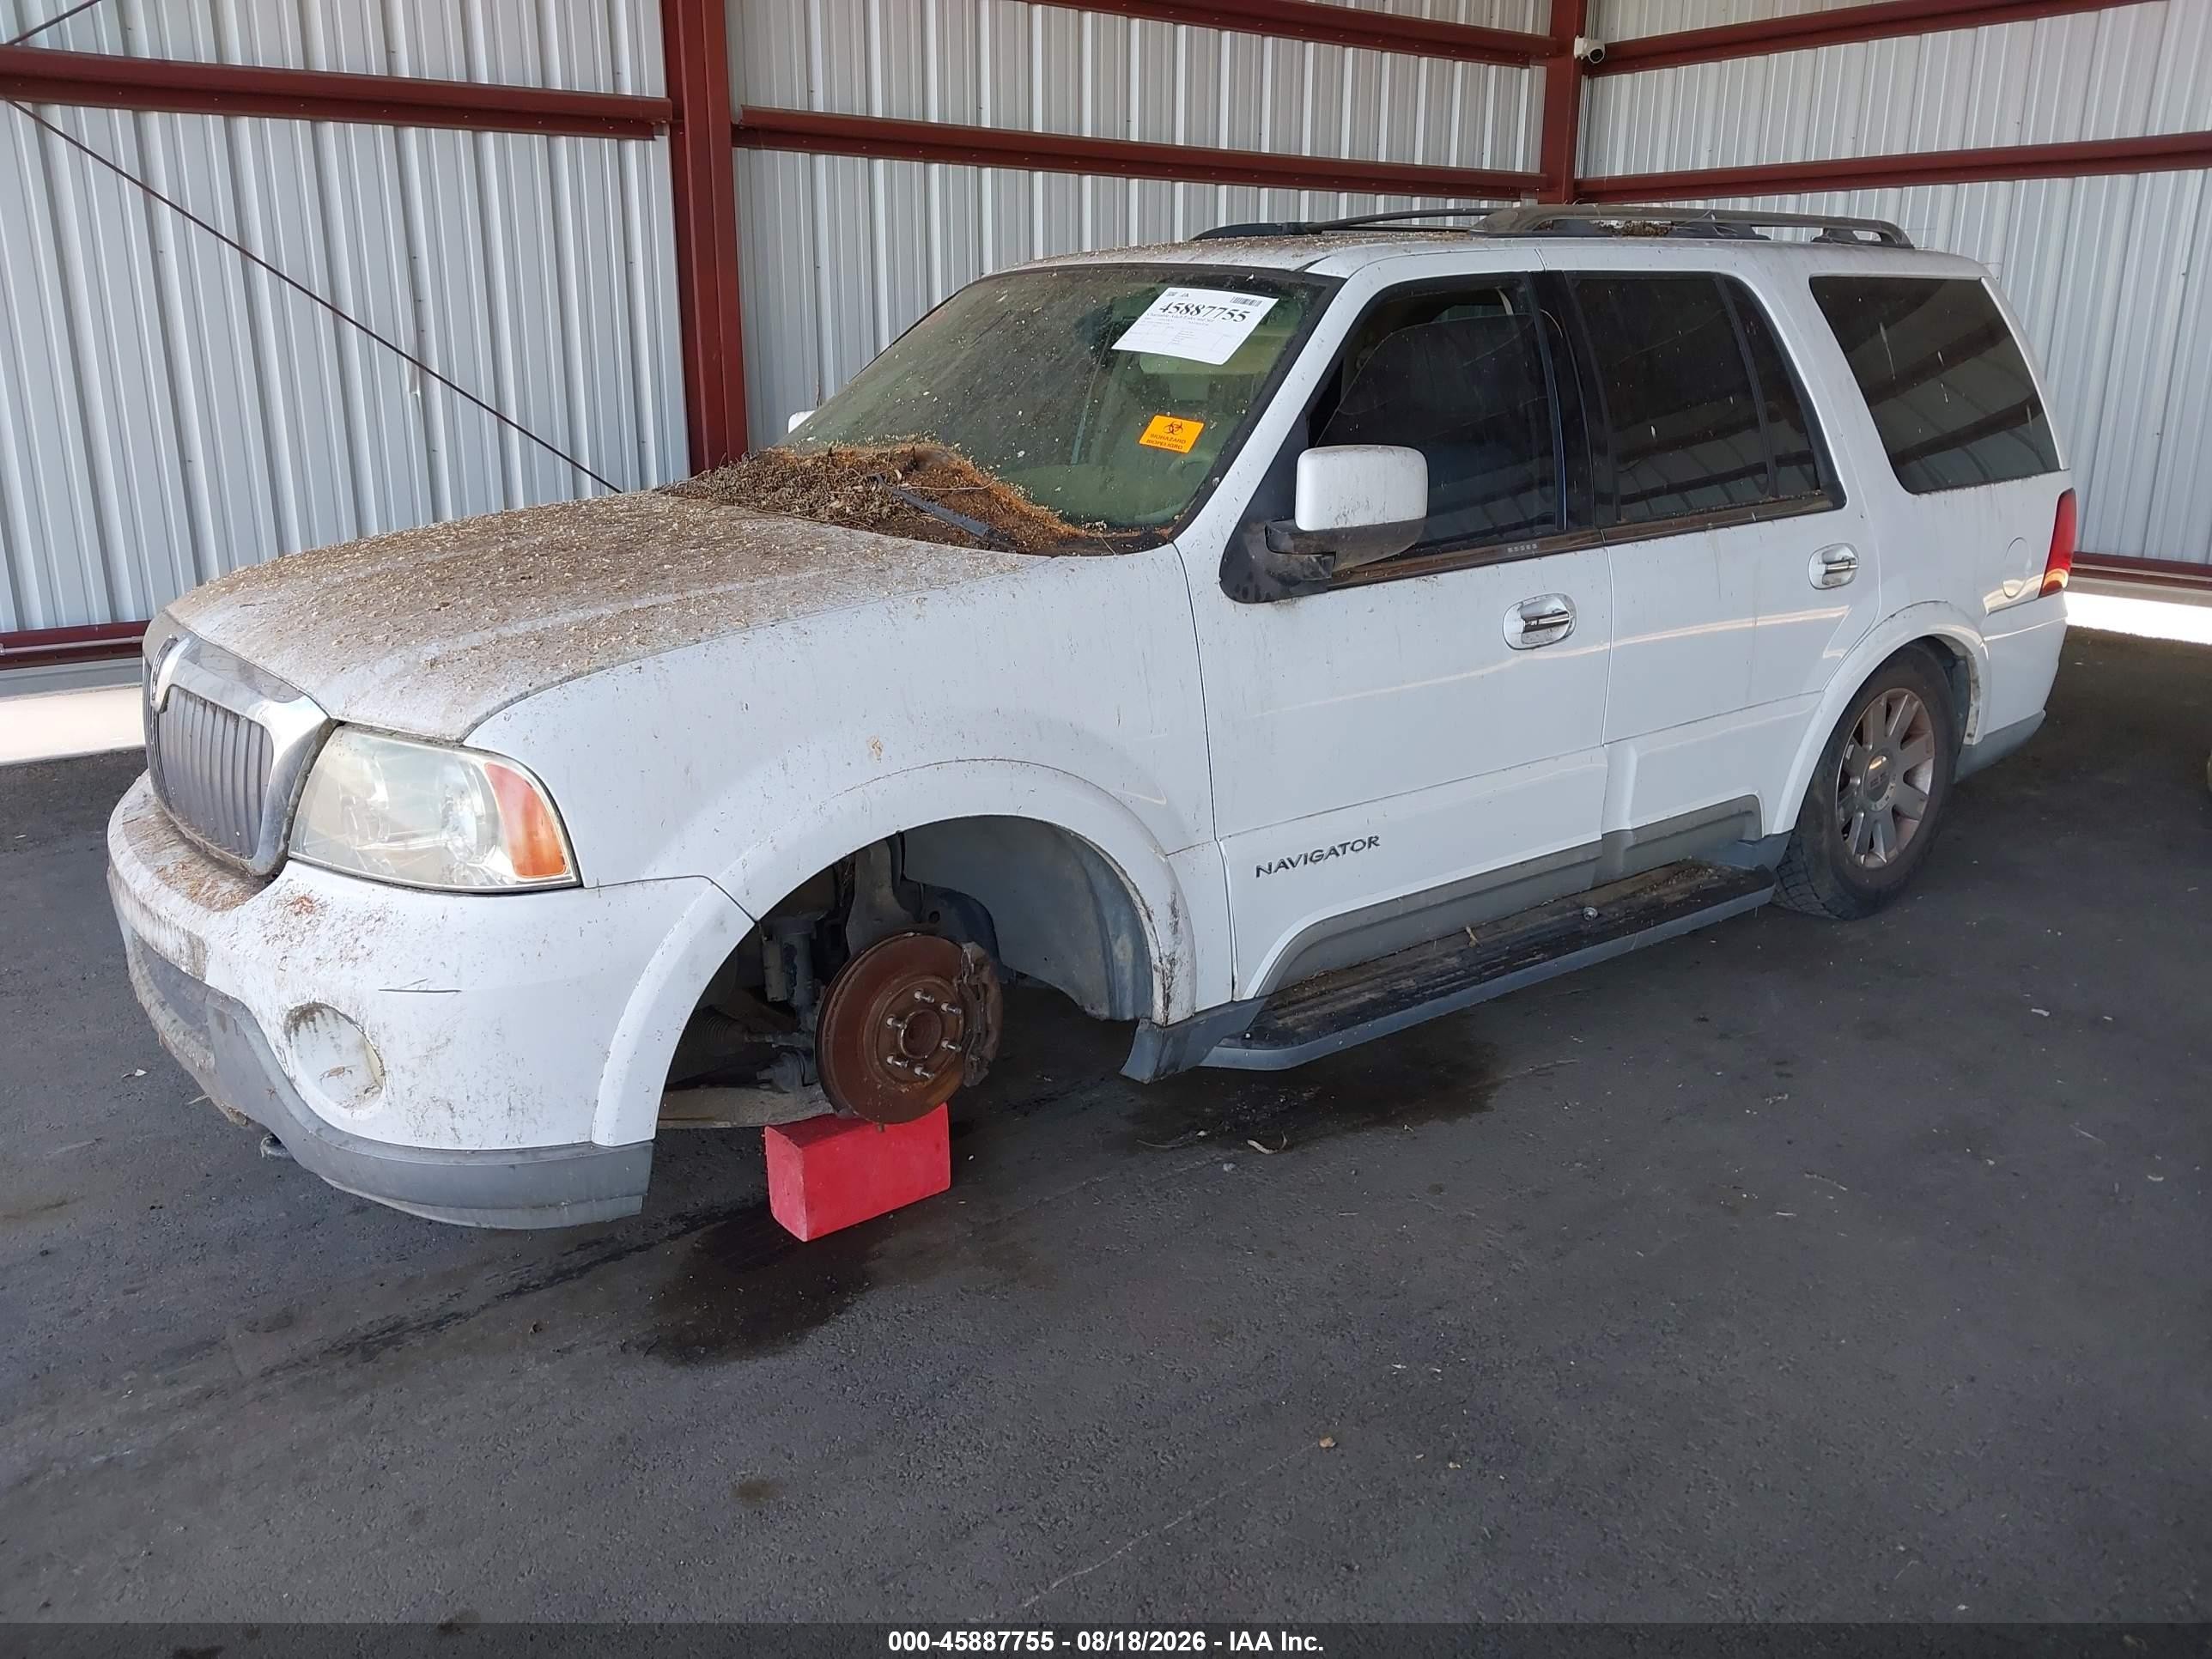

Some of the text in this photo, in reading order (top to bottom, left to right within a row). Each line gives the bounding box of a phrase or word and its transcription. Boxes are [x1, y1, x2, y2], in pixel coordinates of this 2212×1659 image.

[1159, 301, 1250, 322] 45887755
[1146, 439, 1182, 449] BIOPELIGRO
[1150, 434, 1187, 444] BIOHAZARD
[1255, 835, 1381, 878] NAVIGATOR
